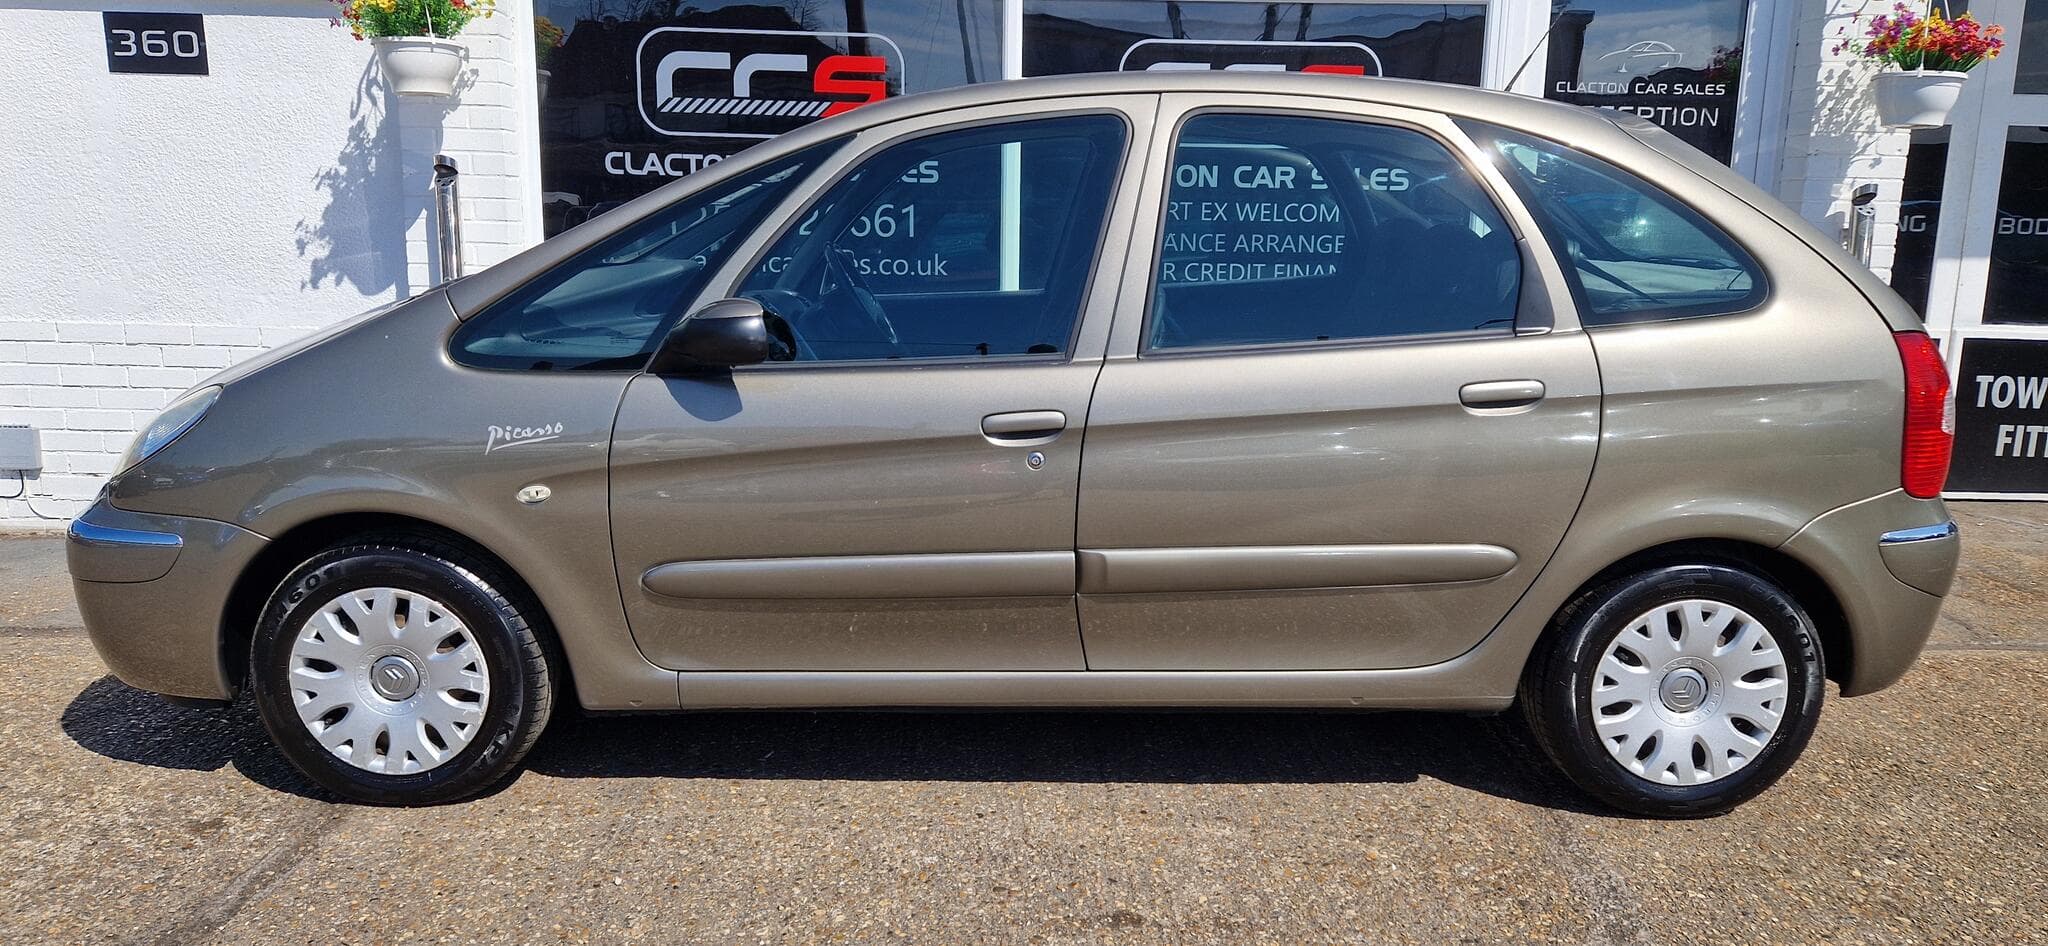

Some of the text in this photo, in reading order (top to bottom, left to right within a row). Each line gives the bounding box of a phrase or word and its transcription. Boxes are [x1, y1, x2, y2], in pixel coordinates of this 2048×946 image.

[111, 29, 200, 58] 360
[1556, 81, 1726, 96] CLACTON CAR SALES
[1582, 106, 1719, 127] PTION
[1176, 164, 1410, 191] ON CAR SLES
[1169, 201, 1340, 223] RT EX WELCOM
[1898, 214, 1927, 233] NG
[1164, 233, 1346, 254] ANCE ARRANGE
[1184, 263, 1266, 282] CREDIT
[1976, 375, 2048, 410] TOW
[485, 422, 564, 455] Picasso
